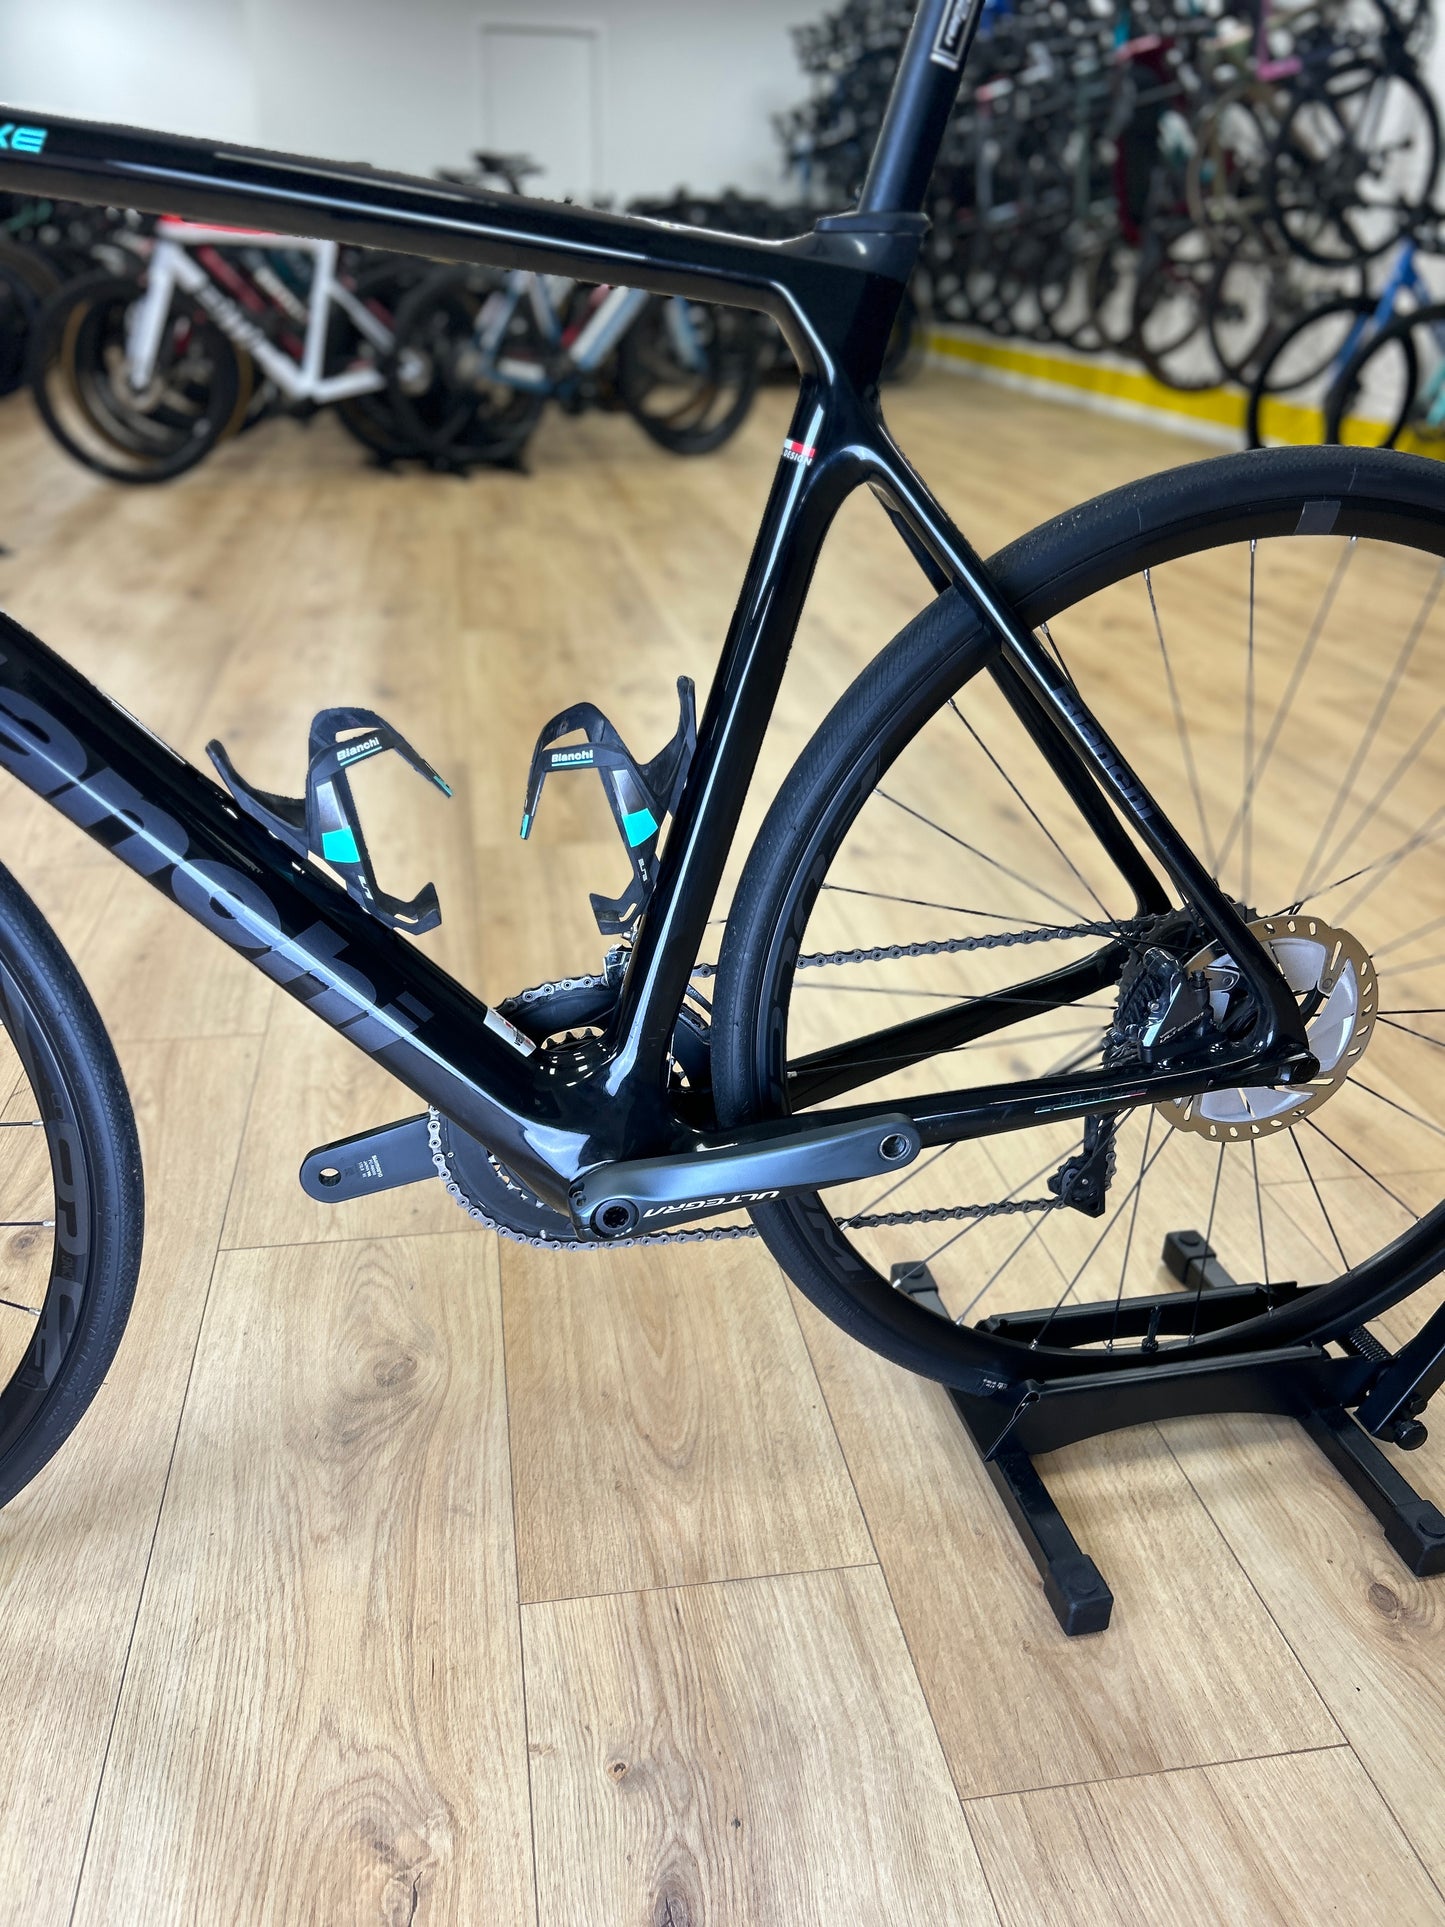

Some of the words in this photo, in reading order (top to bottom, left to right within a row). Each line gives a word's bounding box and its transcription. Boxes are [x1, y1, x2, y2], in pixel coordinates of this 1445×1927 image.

[783, 449, 813, 466] DESIGN
[336, 736, 380, 762] Bianchi
[551, 749, 594, 763] Bianchi
[642, 1190, 780, 1218] ULTEGRA
